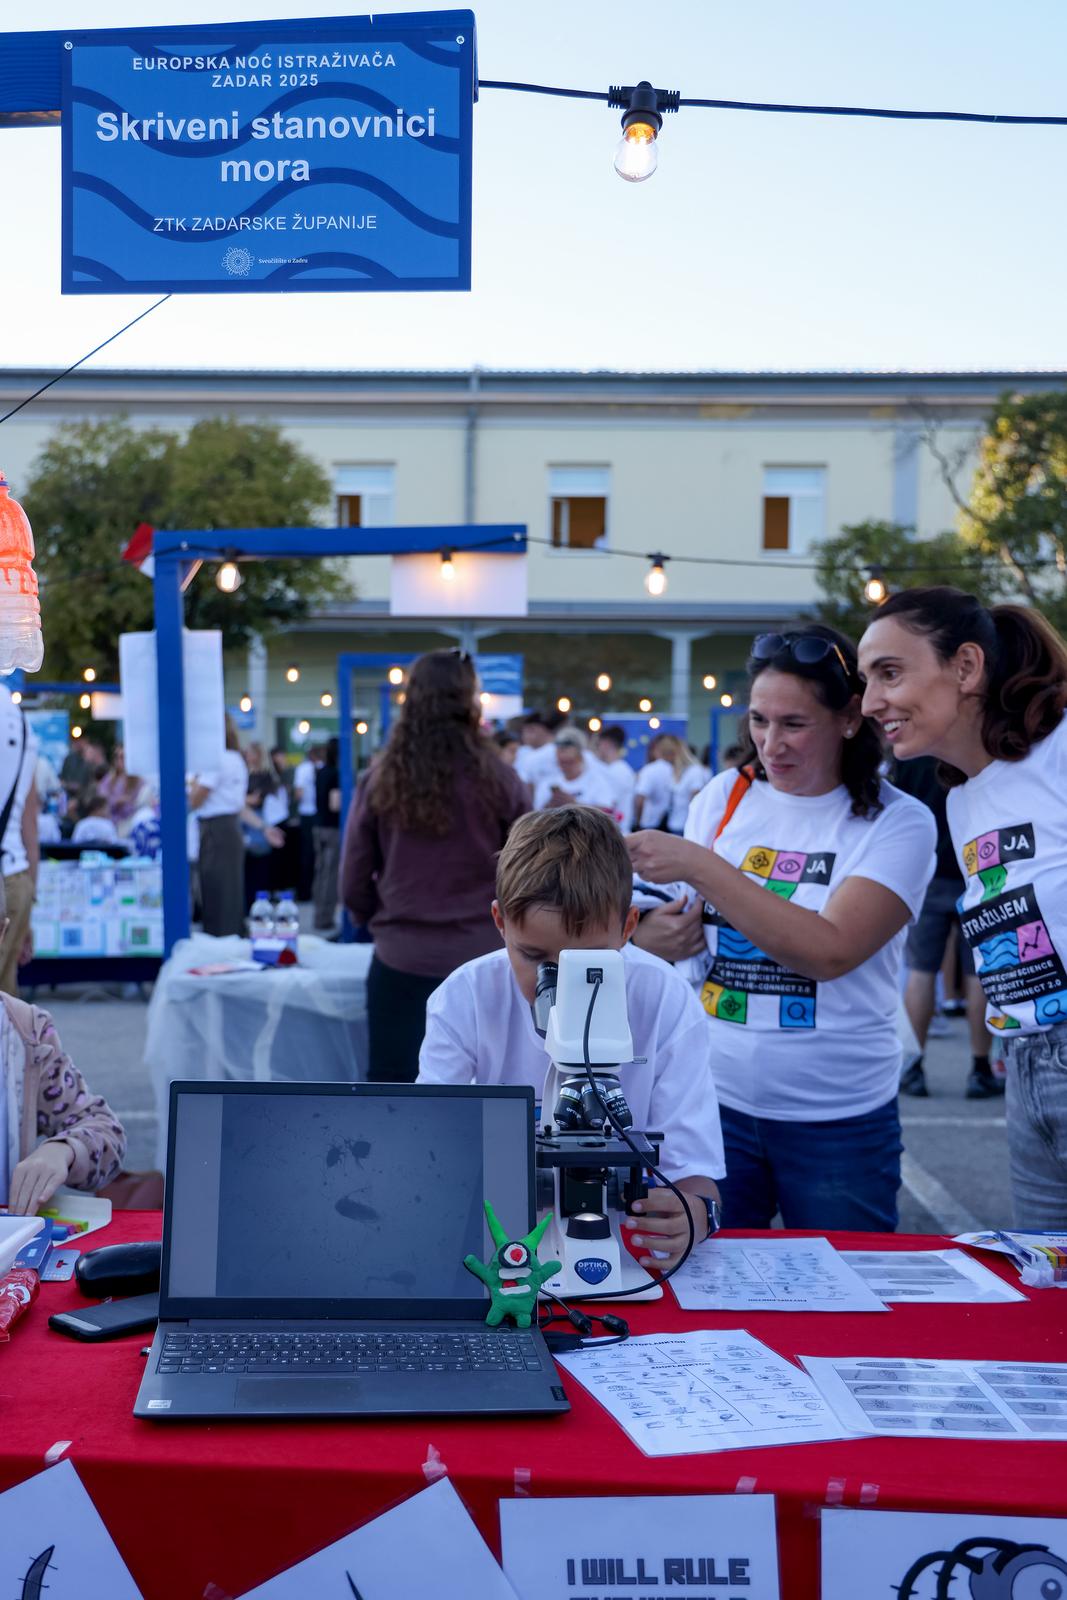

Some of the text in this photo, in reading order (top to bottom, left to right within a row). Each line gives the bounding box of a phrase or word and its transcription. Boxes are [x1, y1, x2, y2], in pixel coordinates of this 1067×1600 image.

[133, 52, 396, 70] EUROPSKA NOĆ ISTRAŽIVAČA
[211, 73, 319, 88] ZADAR 2025
[96, 107, 435, 142] Skriveni stanovnici
[221, 156, 310, 182] mora
[153, 213, 377, 232] ZTK ZADARSKE ŽUPANIJE
[1003, 834, 1030, 851] JA
[806, 859, 827, 875] JA
[566, 1557, 751, 1586] I WILL RULE
